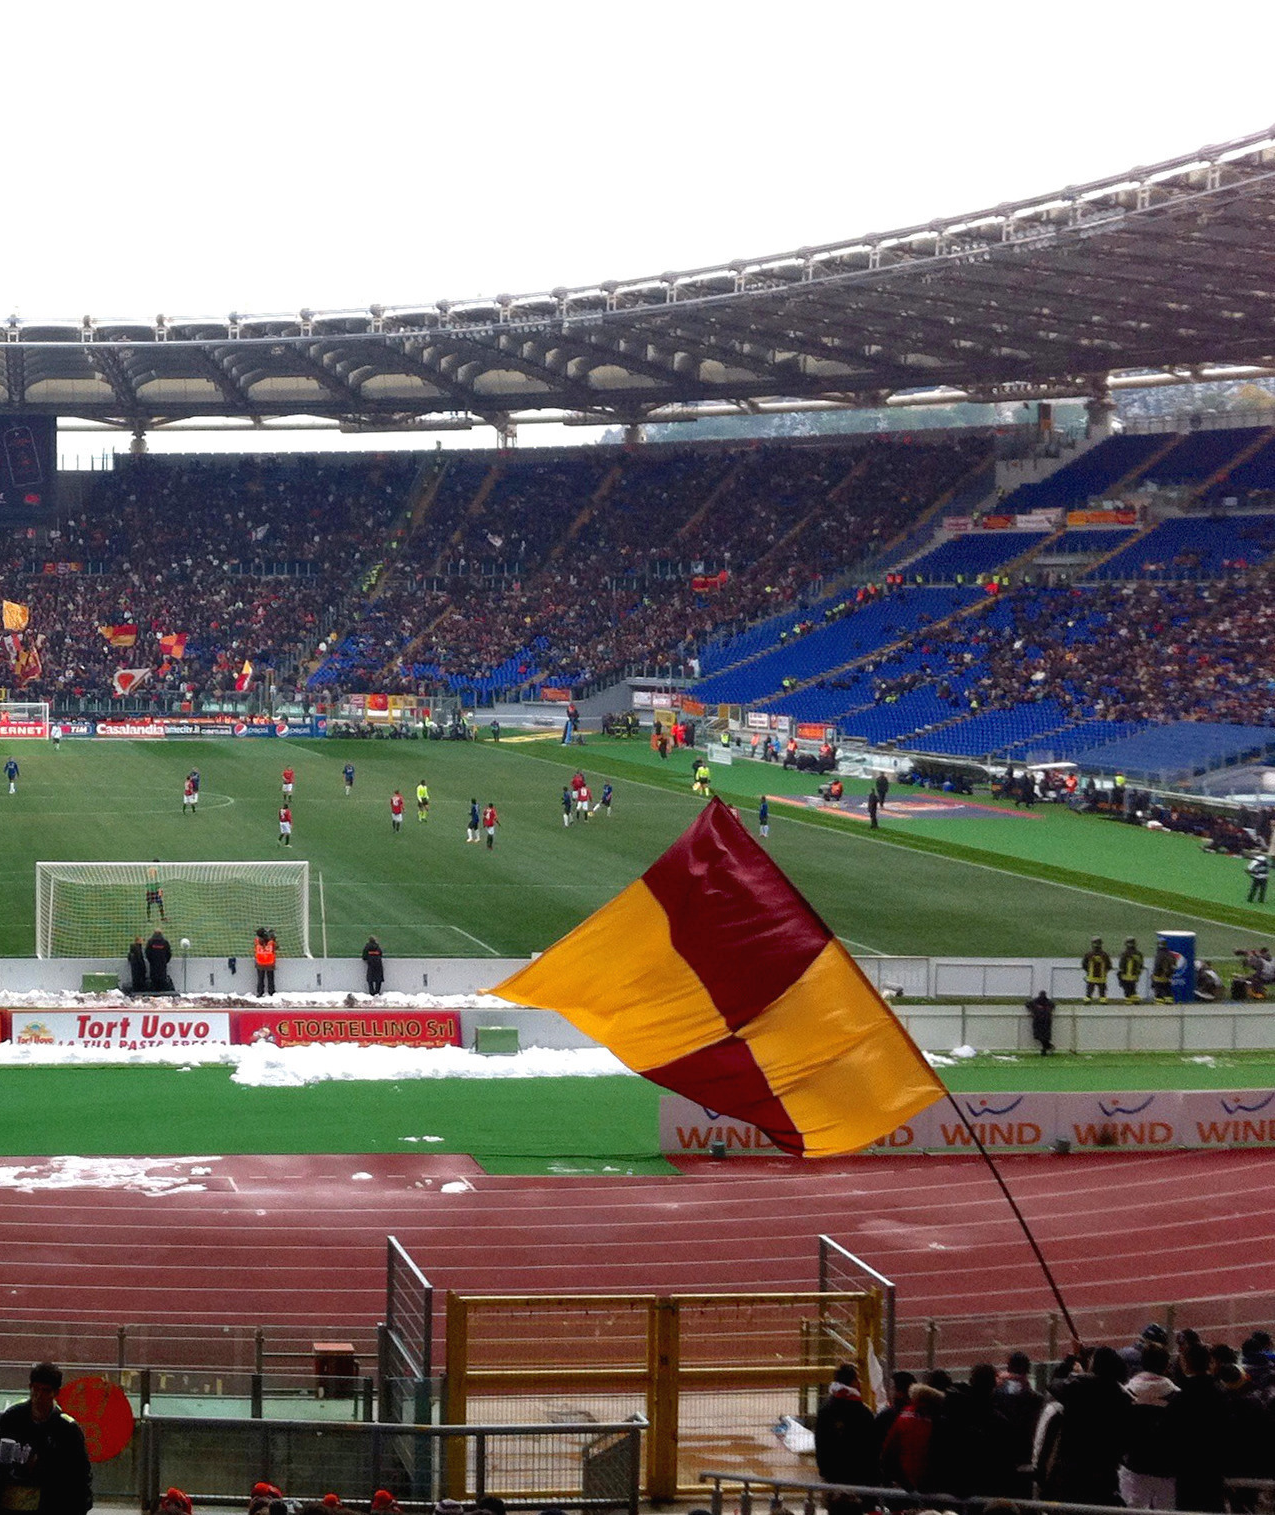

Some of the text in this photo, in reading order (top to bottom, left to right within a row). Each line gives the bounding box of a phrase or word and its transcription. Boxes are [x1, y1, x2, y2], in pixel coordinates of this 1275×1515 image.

[96, 723, 165, 735] Casalandia
[248, 726, 269, 735] pepsi
[289, 726, 311, 735] pepsi
[76, 1015, 210, 1038] Tort Uovo
[293, 1019, 421, 1038] TORTELLINO
[940, 1122, 1042, 1146] WIND
[1072, 1121, 1174, 1145] WIND
